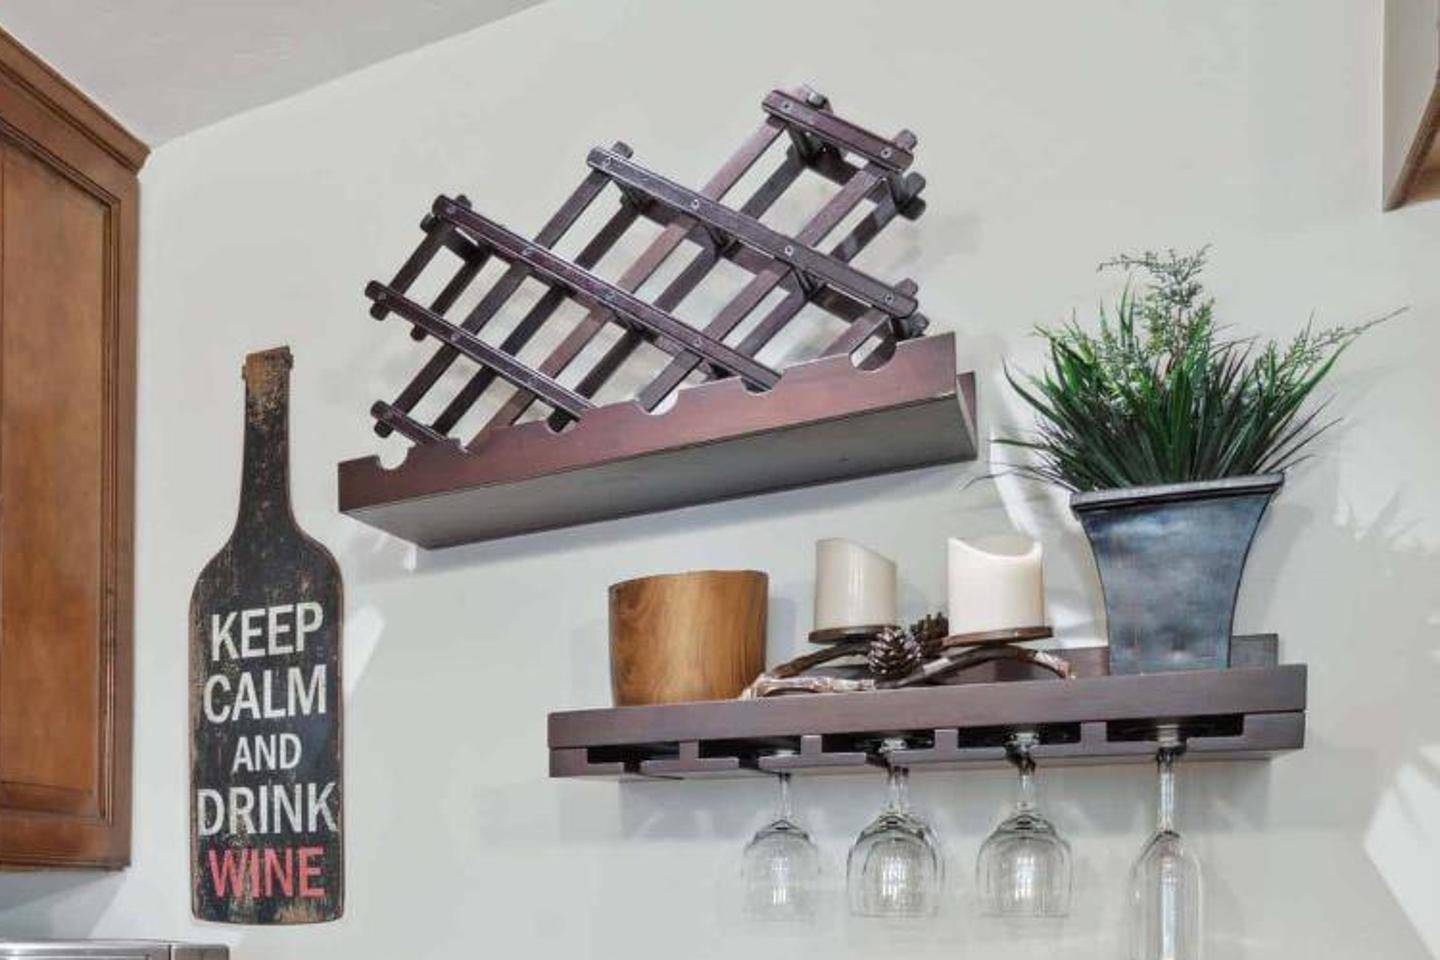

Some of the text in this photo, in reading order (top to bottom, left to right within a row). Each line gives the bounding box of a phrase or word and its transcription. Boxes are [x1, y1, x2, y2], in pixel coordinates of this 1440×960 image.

[211, 601, 324, 661] KEEP
[203, 664, 327, 724] CALM
[231, 733, 302, 773] AND
[198, 781, 338, 836] DRINK
[208, 845, 325, 899] WINE
